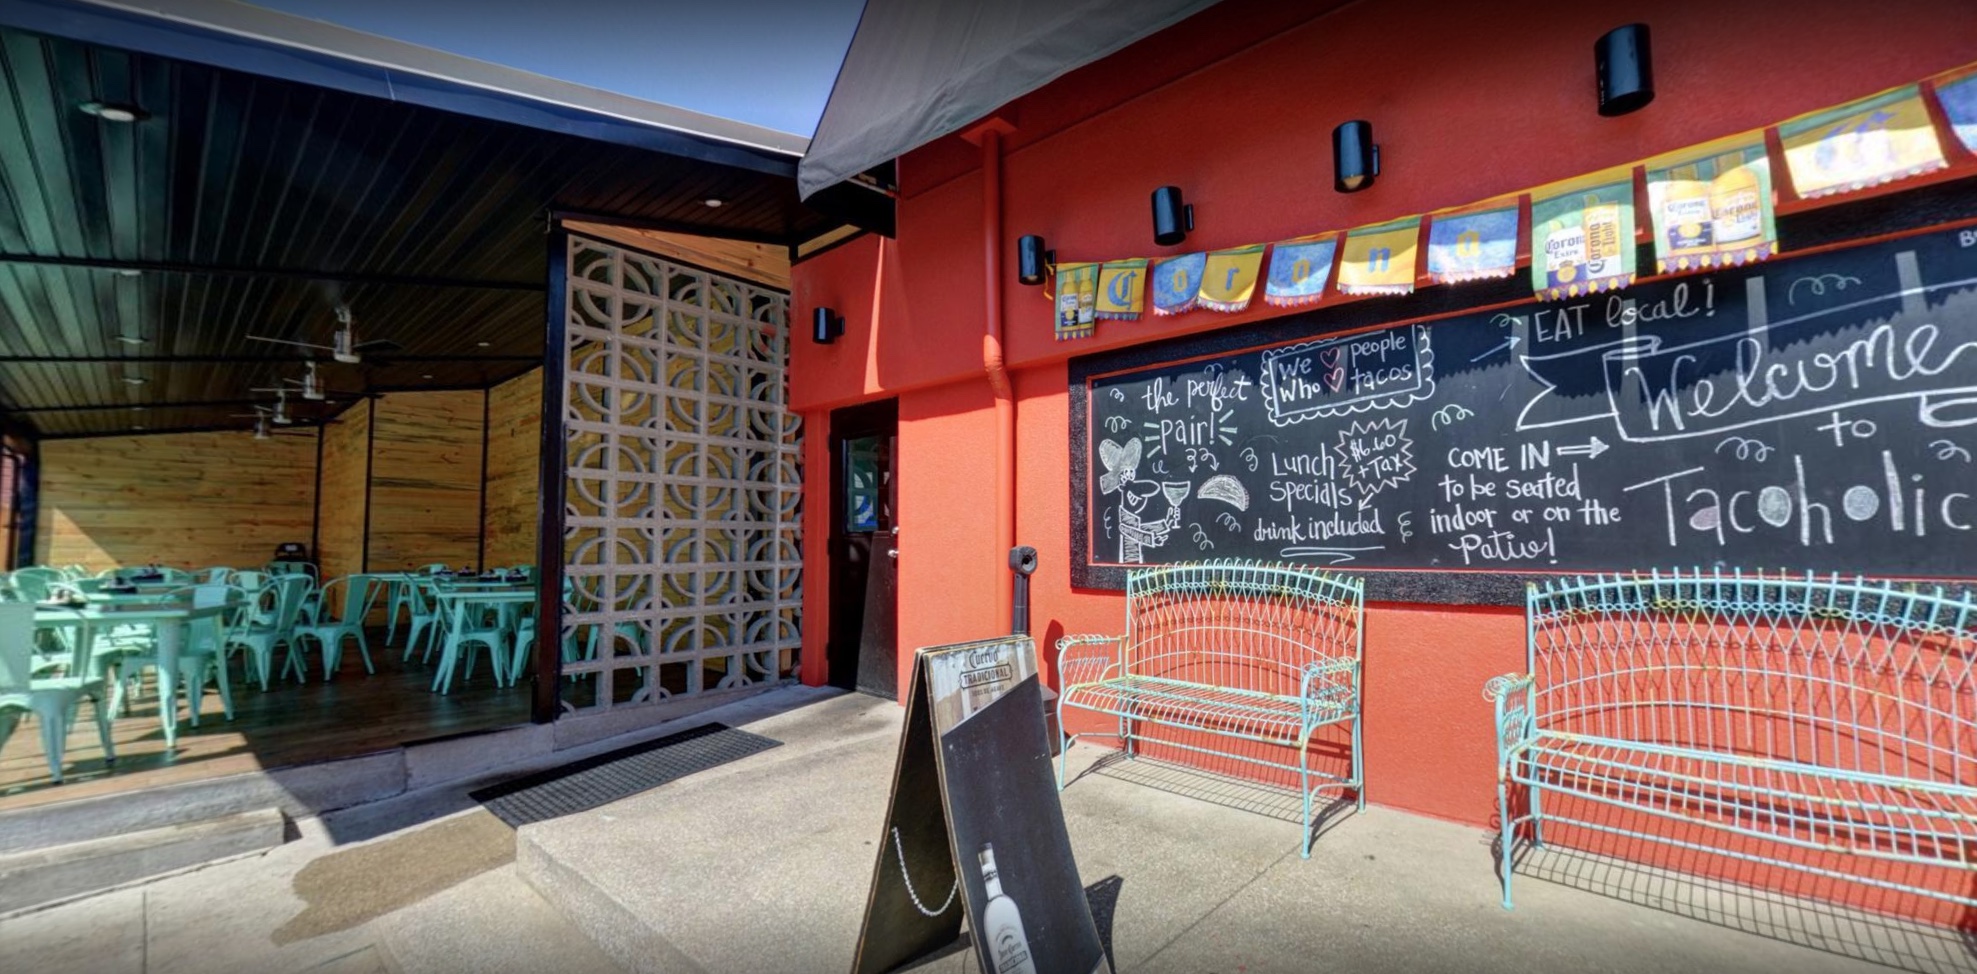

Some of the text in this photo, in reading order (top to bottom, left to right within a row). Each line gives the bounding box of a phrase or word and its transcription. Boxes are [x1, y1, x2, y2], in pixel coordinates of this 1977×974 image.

[1545, 234, 1585, 254] Coron
[1959, 229, 1977, 248] B
[1535, 278, 1715, 343] EAT local!
[1279, 332, 1406, 379] We people
[1142, 375, 1252, 414] the perfect
[1351, 363, 1411, 394] tacos
[1624, 324, 1977, 431] Welcome
[1161, 411, 1215, 455] pair!
[1817, 411, 1877, 447] to
[1272, 442, 1335, 480] Lunch
[1350, 434, 1396, 462] $6.60
[1448, 440, 1550, 472] COME IN
[1367, 453, 1404, 479] Tax
[1438, 462, 1582, 502] to be seated
[1269, 479, 1353, 512] Specials
[1623, 450, 1972, 547] Tacoholic
[1254, 508, 1386, 544] drink included
[1430, 499, 1621, 534] indoor or on the
[963, 667, 1009, 685] TRADICIONAL
[969, 650, 999, 668] Cuervo
